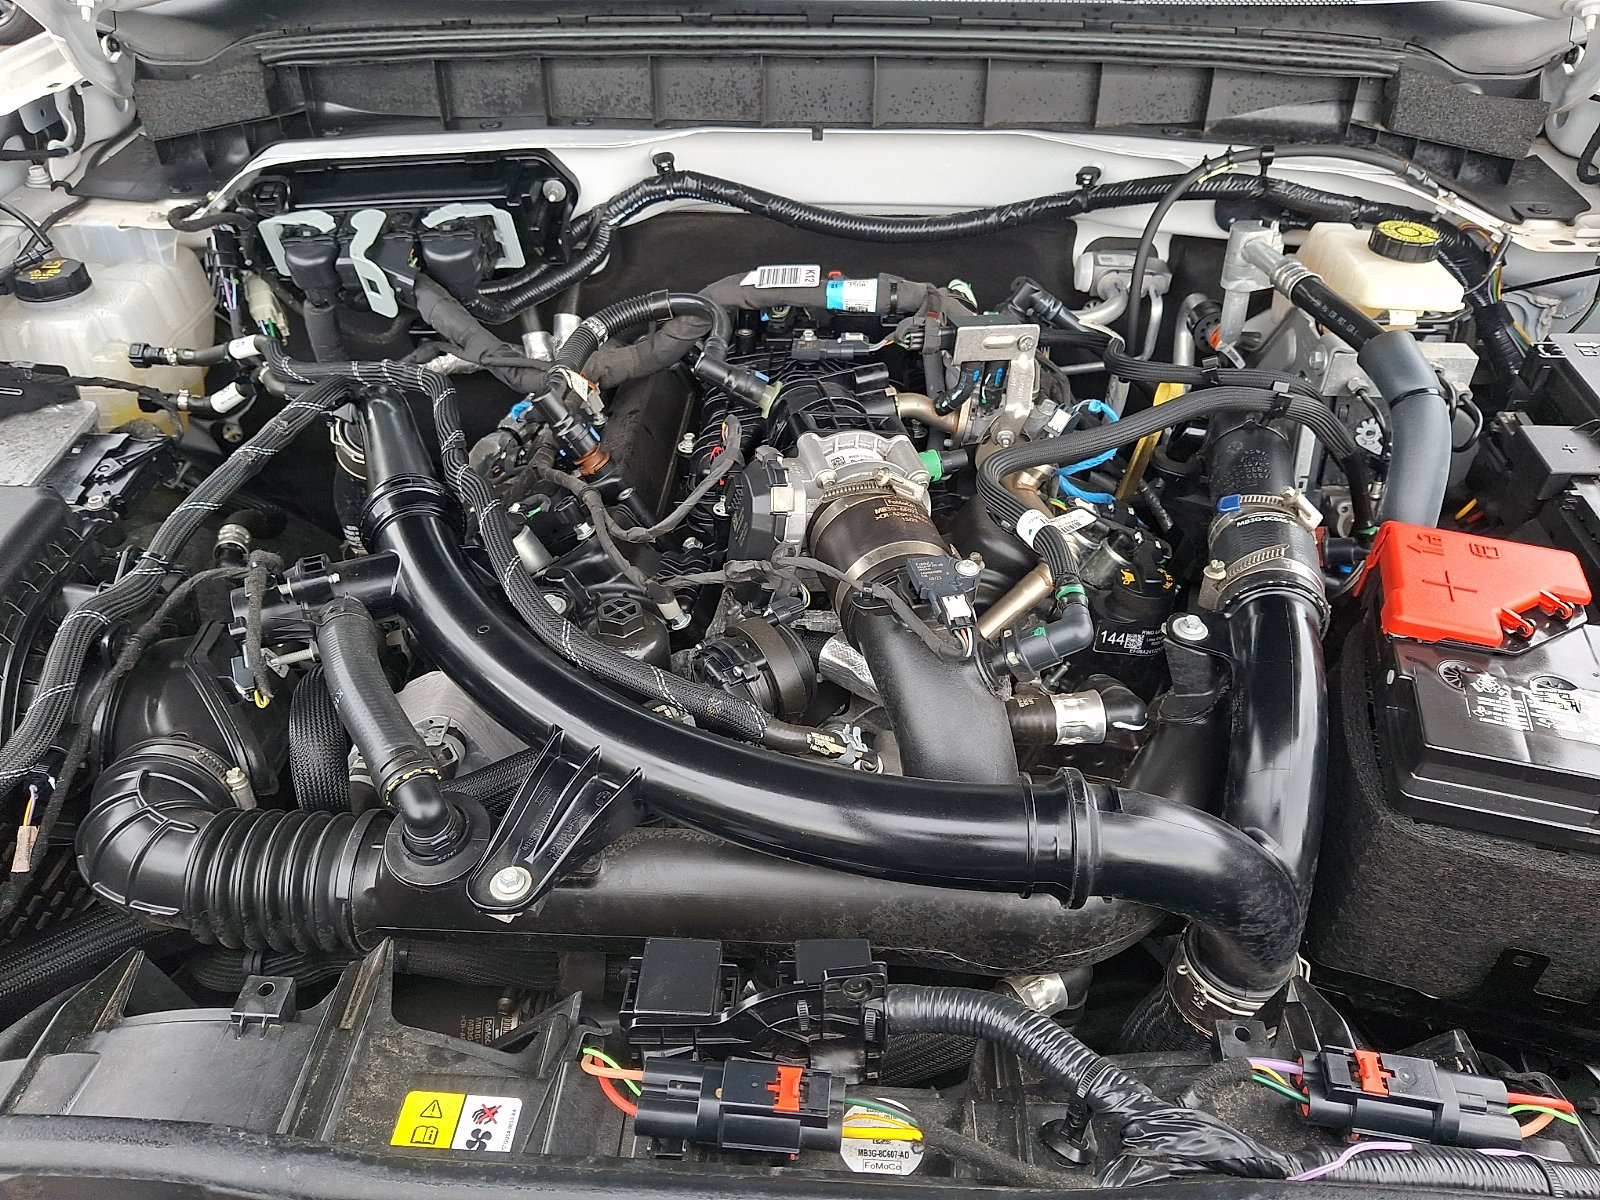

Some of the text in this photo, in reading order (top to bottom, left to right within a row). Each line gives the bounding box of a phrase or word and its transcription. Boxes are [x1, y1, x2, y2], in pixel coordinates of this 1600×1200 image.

[805, 269, 815, 283] K12
[1101, 630, 1125, 645] 144
[864, 1161, 902, 1171] FoMoCo
